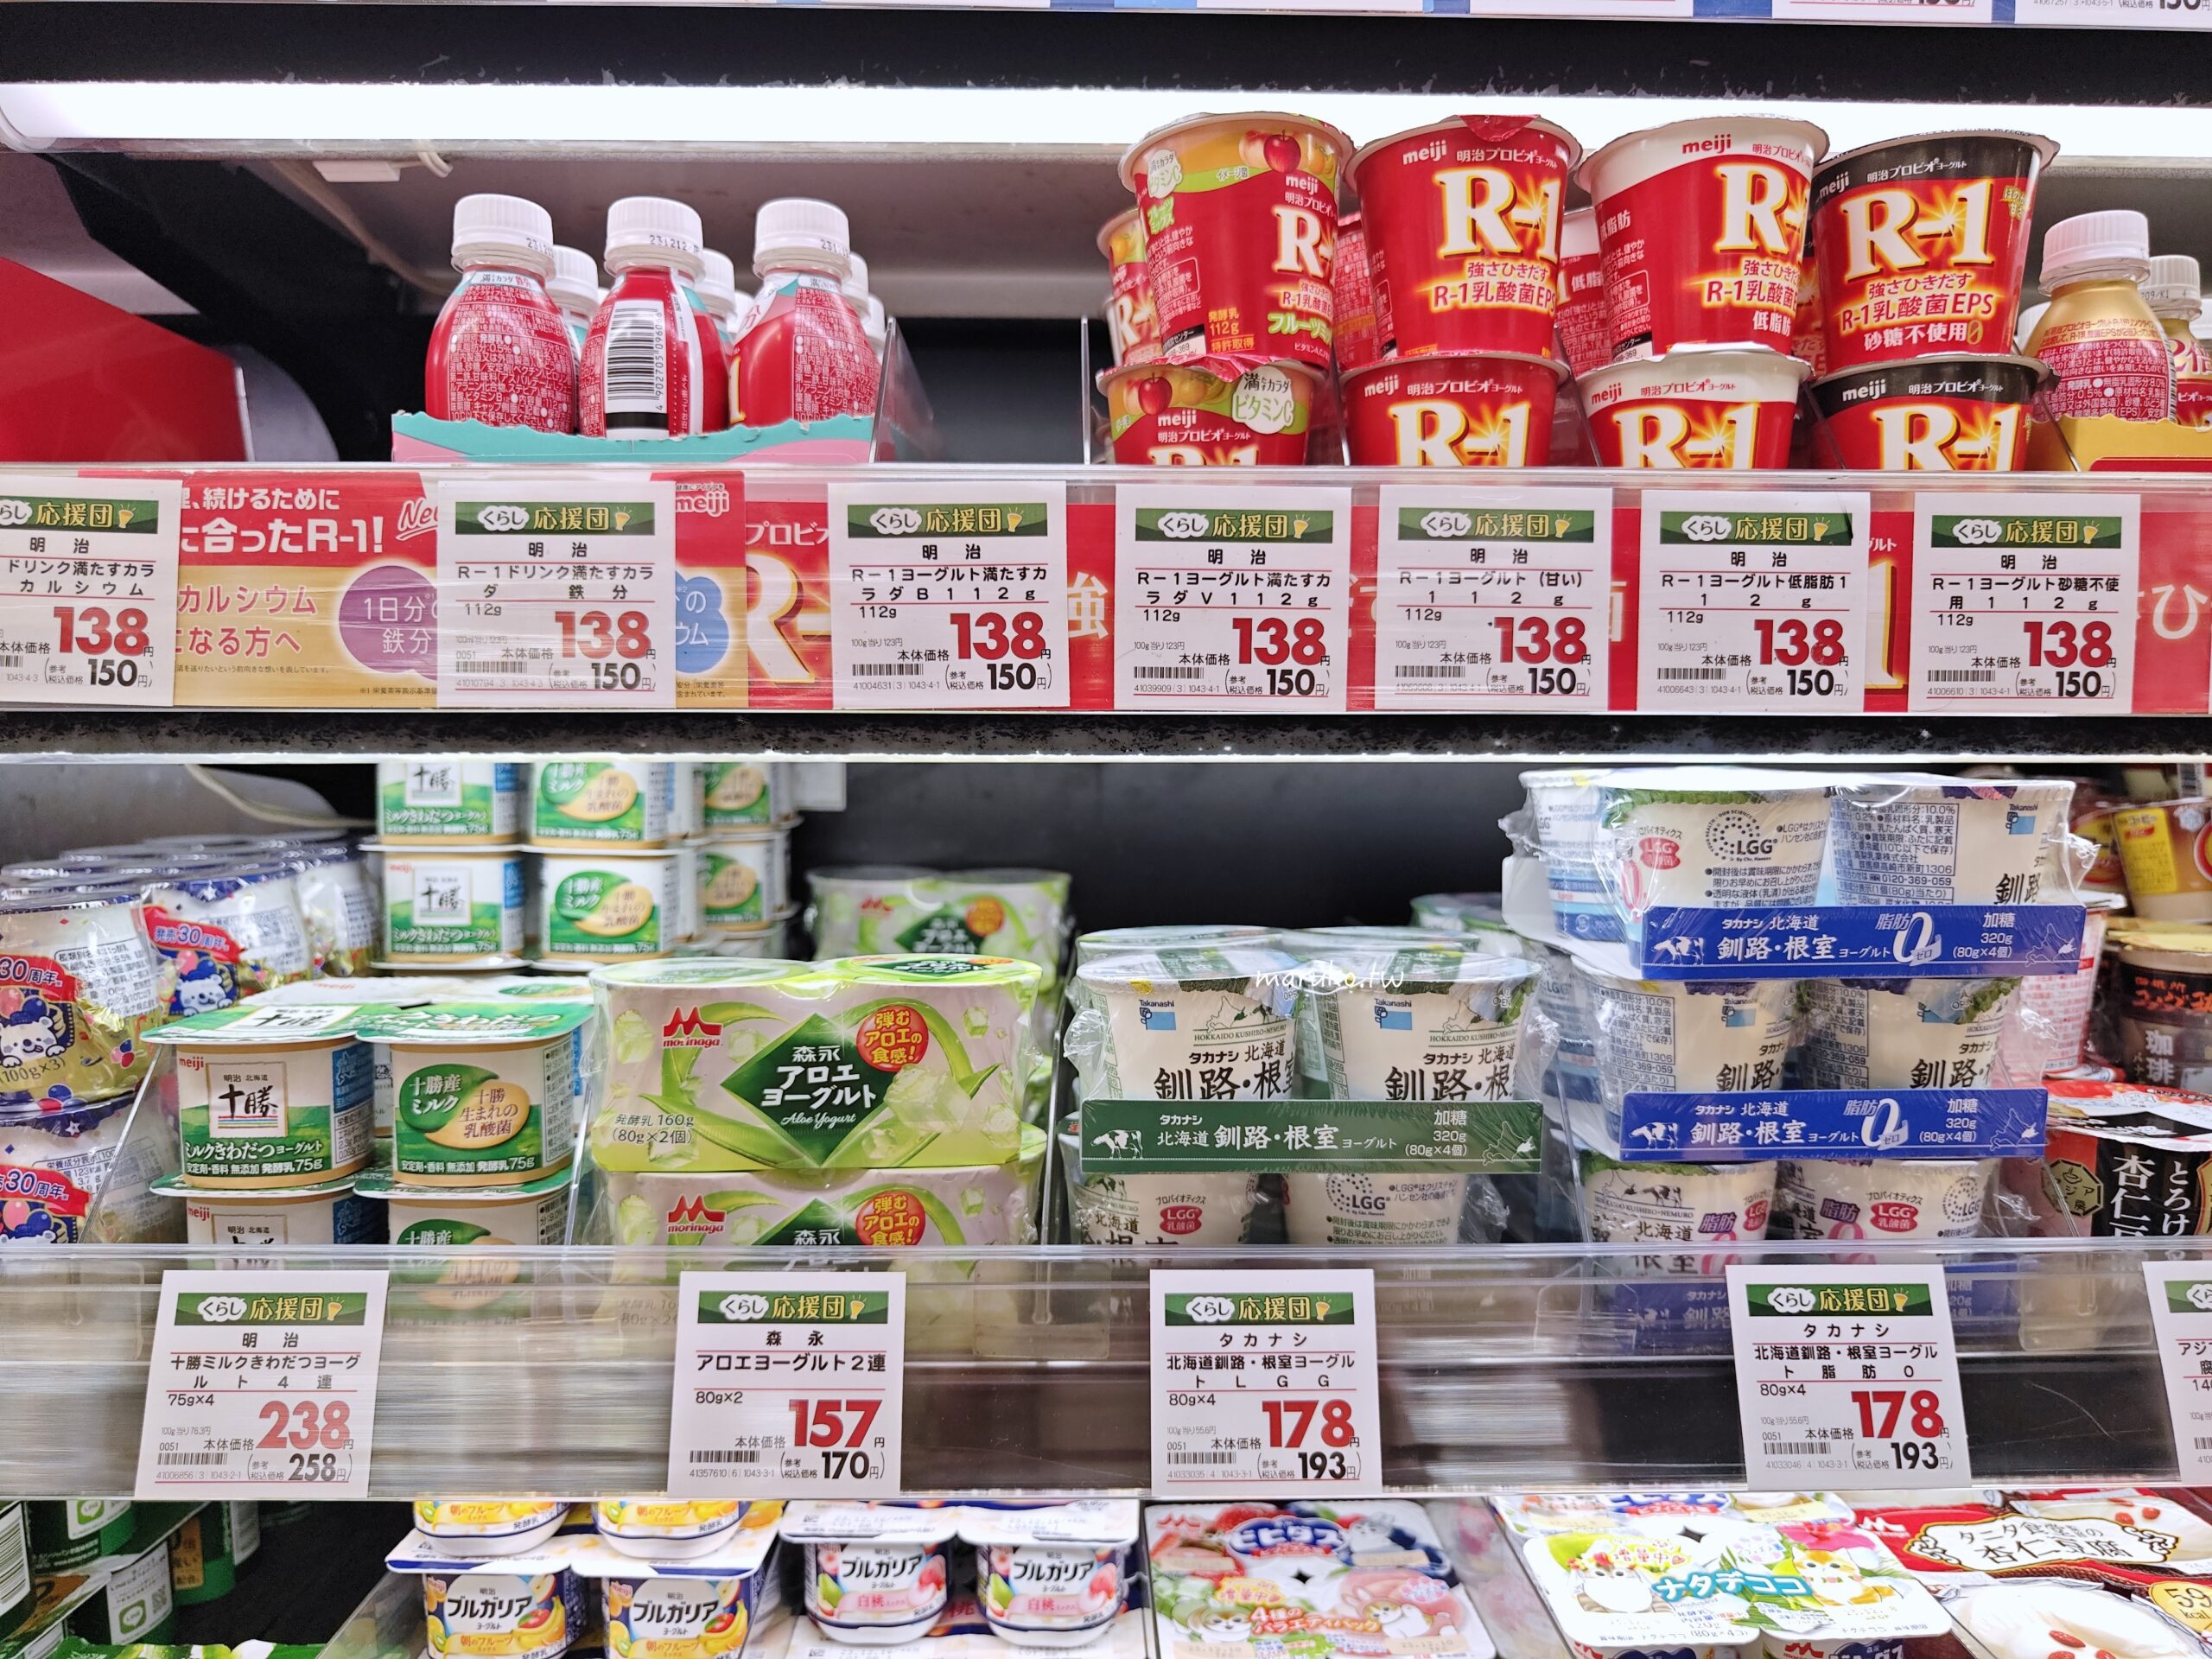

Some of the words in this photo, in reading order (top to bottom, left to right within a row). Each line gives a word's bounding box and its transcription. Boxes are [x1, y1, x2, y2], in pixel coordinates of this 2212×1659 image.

[1402, 139, 1447, 165] meiji
[1682, 134, 1731, 156] meiji
[1286, 175, 1319, 193] meiji
[1820, 172, 1850, 200] meiji
[1433, 168, 1561, 264] R-1
[1840, 180, 1994, 283] R-1
[1467, 261, 1549, 280] 強さひきだす
[1869, 272, 1973, 300] 強さひきだす
[1208, 308, 1239, 321] 発酵乳
[1841, 293, 1994, 332] R-1乳酸菌EPS
[1209, 322, 1240, 335] 112g
[1752, 310, 1791, 337] 低脂肪
[1211, 336, 1254, 353] 特許取得
[1863, 322, 1967, 351] 砂糖不使用
[1364, 374, 1399, 397] meiji
[1842, 380, 1886, 402] meiji
[1592, 383, 1622, 405] meiji
[1235, 395, 1294, 424] ビタミンC
[1158, 410, 1197, 429] meiji
[676, 492, 729, 517] meiji
[30, 537, 90, 554] 明治
[529, 543, 588, 559] 明治
[922, 543, 982, 561] 明治
[1208, 550, 1266, 565] 明治
[1471, 549, 1529, 565] 明治
[1731, 551, 1787, 568] 明治
[2001, 555, 2057, 570] 明治
[9, 559, 154, 577] ドリンク満たすカラ
[20, 580, 143, 596] カルシウム
[178, 584, 318, 614] カルシウム
[465, 604, 502, 617] 112g
[861, 606, 898, 619] 112g
[1144, 609, 1180, 622] 112g
[1406, 608, 1442, 621] 112g
[1668, 612, 1704, 624] 112g
[1938, 614, 1974, 626] 112g
[382, 629, 433, 655] 鉄分
[501, 648, 555, 661] 本体価格
[898, 649, 950, 662] 本体価格
[1179, 653, 1230, 665] 本体価格
[1440, 652, 1491, 665] 本体価格
[1701, 655, 1751, 666] 本体価格
[1972, 657, 2021, 669] 本体価格
[1882, 874, 1952, 886] 0120-369-059
[1722, 918, 1764, 931] タカナシ
[1769, 914, 1819, 932] 北海道
[1875, 912, 1910, 931] 脂肪
[1981, 912, 2016, 929] 加糖
[1980, 931, 2012, 945] 320g
[1839, 947, 1891, 959] ヨーグルト
[1139, 1000, 1175, 1008] Takanashi
[1374, 999, 1413, 1008] Takanashi
[875, 1011, 911, 1030] 弾む
[663, 1037, 722, 1048] morinaga
[865, 1030, 923, 1046] アロエの
[791, 1046, 842, 1062] 森永
[1188, 1051, 1239, 1065] タカナシ
[1244, 1041, 1285, 1062] 北海道
[1423, 1053, 1473, 1065] タカナシ
[179, 1056, 204, 1070] meiji
[223, 1073, 242, 1083] 明治
[245, 1073, 269, 1082] 北海道
[410, 1075, 461, 1095] 十勝産
[778, 1065, 860, 1090] アロエ
[218, 1084, 278, 1120] 十勝
[411, 1095, 460, 1114] ミルク
[474, 1088, 505, 1106] 十勝
[761, 1085, 877, 1109] ヨーグルト
[460, 1104, 518, 1122] 生まれの
[1694, 1104, 1735, 1116] タカナシ
[1740, 1101, 1789, 1117] 北海道
[1843, 1099, 1877, 1117] 脂肪
[1947, 1098, 1978, 1114] 加糖
[616, 1114, 653, 1127] 発酵乳
[658, 1114, 695, 1128] 160g
[782, 1112, 813, 1125] Aloe
[815, 1113, 856, 1130] Yogurt
[1160, 1115, 1203, 1126] タカナシ
[1434, 1109, 1467, 1127] 加糖
[1945, 1117, 1977, 1130] 320g
[464, 1121, 512, 1139] 乳酸菌
[1433, 1130, 1466, 1144] 320g
[1808, 1131, 1859, 1142] ヨーグルト
[1157, 1130, 1208, 1148] 北海道
[1342, 1136, 1397, 1150] ヨーグルト
[231, 1161, 259, 1174] 無添加
[874, 1196, 908, 1213] 弾む
[1821, 1199, 1860, 1223] 脂肪
[188, 1206, 210, 1220] meiji
[668, 1224, 725, 1234] morinaga
[863, 1214, 920, 1231] アロエの
[1166, 1221, 1196, 1231] 乳酸菌
[1877, 1217, 1911, 1230] 乳酸菌
[766, 1331, 824, 1346] 森永
[1804, 1324, 1889, 1338] タカナシ
[242, 1332, 299, 1348] 明治
[1220, 1333, 1306, 1347] タカナシ
[171, 1355, 360, 1370] 十勝ミルクきわだつヨーグ
[697, 1353, 887, 1372] アロエヨーグルト2連
[734, 1436, 786, 1448] 本体価格
[1763, 1433, 1782, 1441] 0051
[1805, 1427, 1854, 1440] 本体価格
[159, 1442, 179, 1451] 0051
[204, 1439, 254, 1451] 本体価格
[1167, 1441, 1186, 1450] 0051
[1211, 1438, 1262, 1450] 本体価格
[1981, 1537, 2133, 1565] 杏仁豆腐
[842, 1555, 924, 1579] ブルガリア
[1014, 1560, 1096, 1581] ブルガリア
[1657, 1573, 1805, 1600] ナタデココ
[448, 1597, 533, 1619] ブルガリア
[633, 1600, 719, 1624] ブルガリア
[2181, 1608, 2209, 1620] kcal
